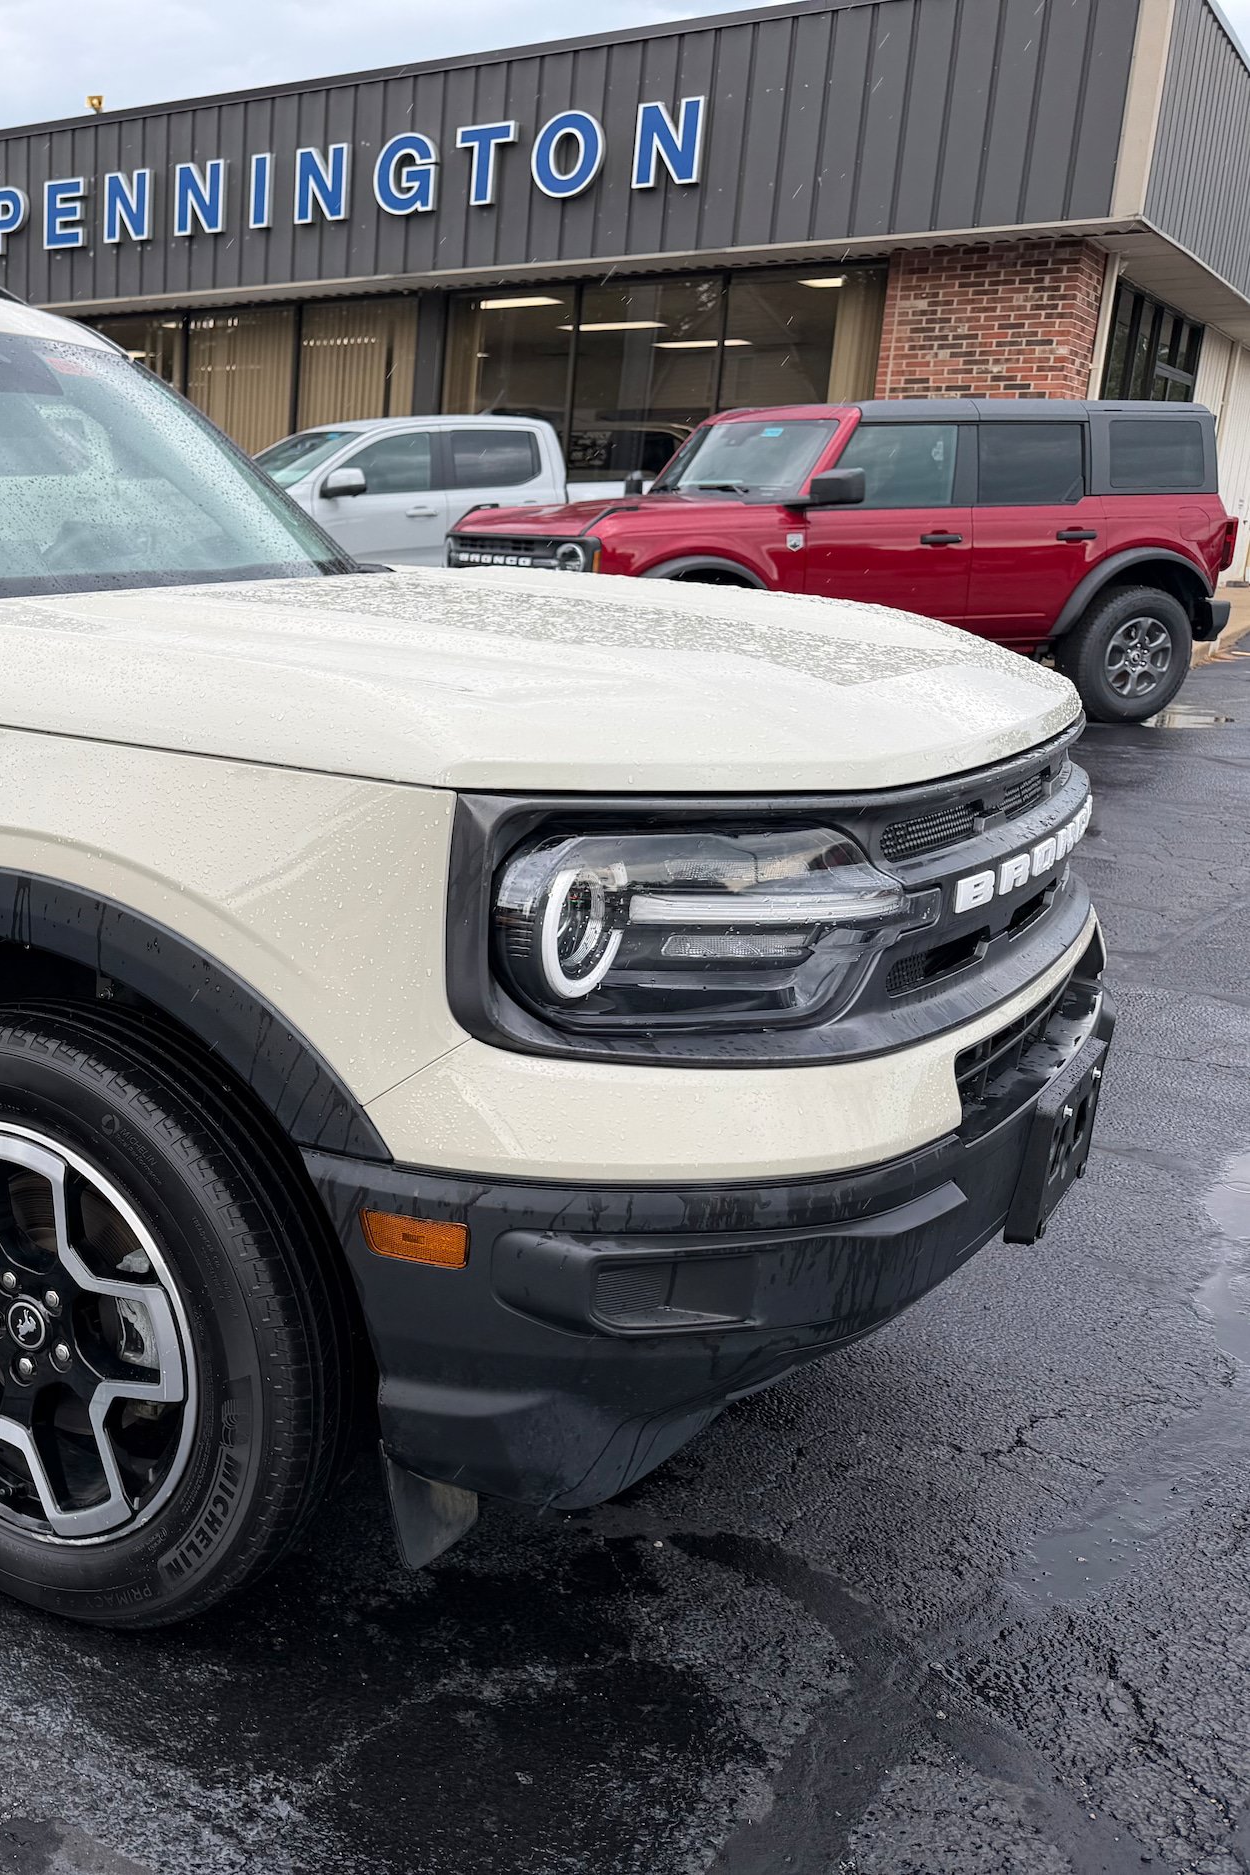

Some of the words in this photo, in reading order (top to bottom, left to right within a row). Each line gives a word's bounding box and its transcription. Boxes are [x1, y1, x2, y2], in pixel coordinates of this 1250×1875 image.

[458, 552, 522, 567] BRONCO
[120, 1128, 157, 1166] MICHELIN
[163, 1453, 241, 1578] MICHELIN
[85, 1583, 153, 1609] PRIMACY
